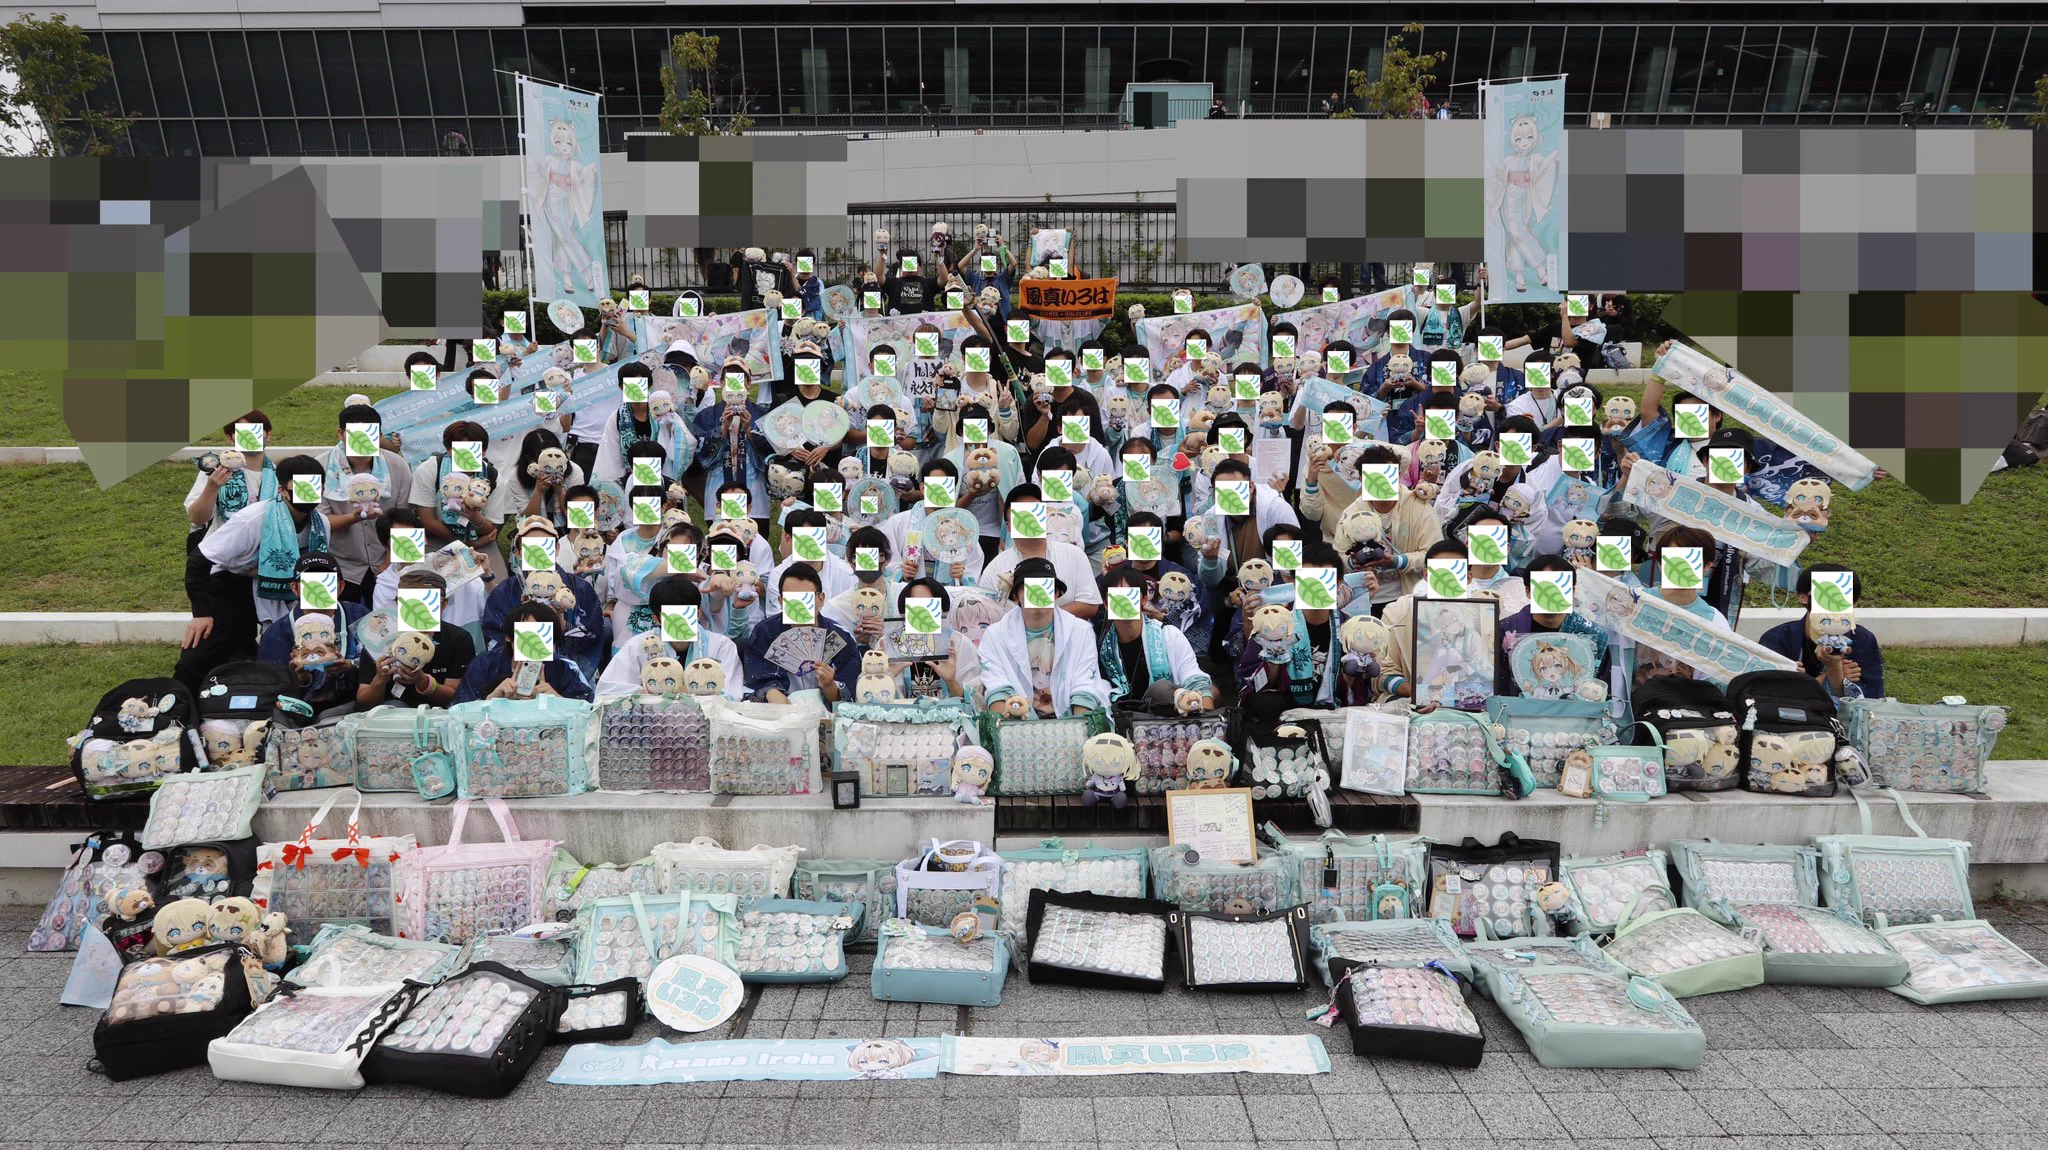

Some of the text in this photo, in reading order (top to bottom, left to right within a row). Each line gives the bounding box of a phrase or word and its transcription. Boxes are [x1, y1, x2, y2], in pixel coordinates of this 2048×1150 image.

[1025, 286, 1110, 307] 風真いろは
[383, 395, 436, 421] Kazama
[492, 408, 529, 428] Iroha
[1722, 382, 1840, 456] 風真いろは
[1666, 484, 1800, 550] 風真いろは
[670, 965, 728, 1003] 風真
[655, 981, 722, 1021] いろは
[639, 1051, 837, 1071] Kazama Iroha
[1065, 1042, 1252, 1066] 風真いろは
